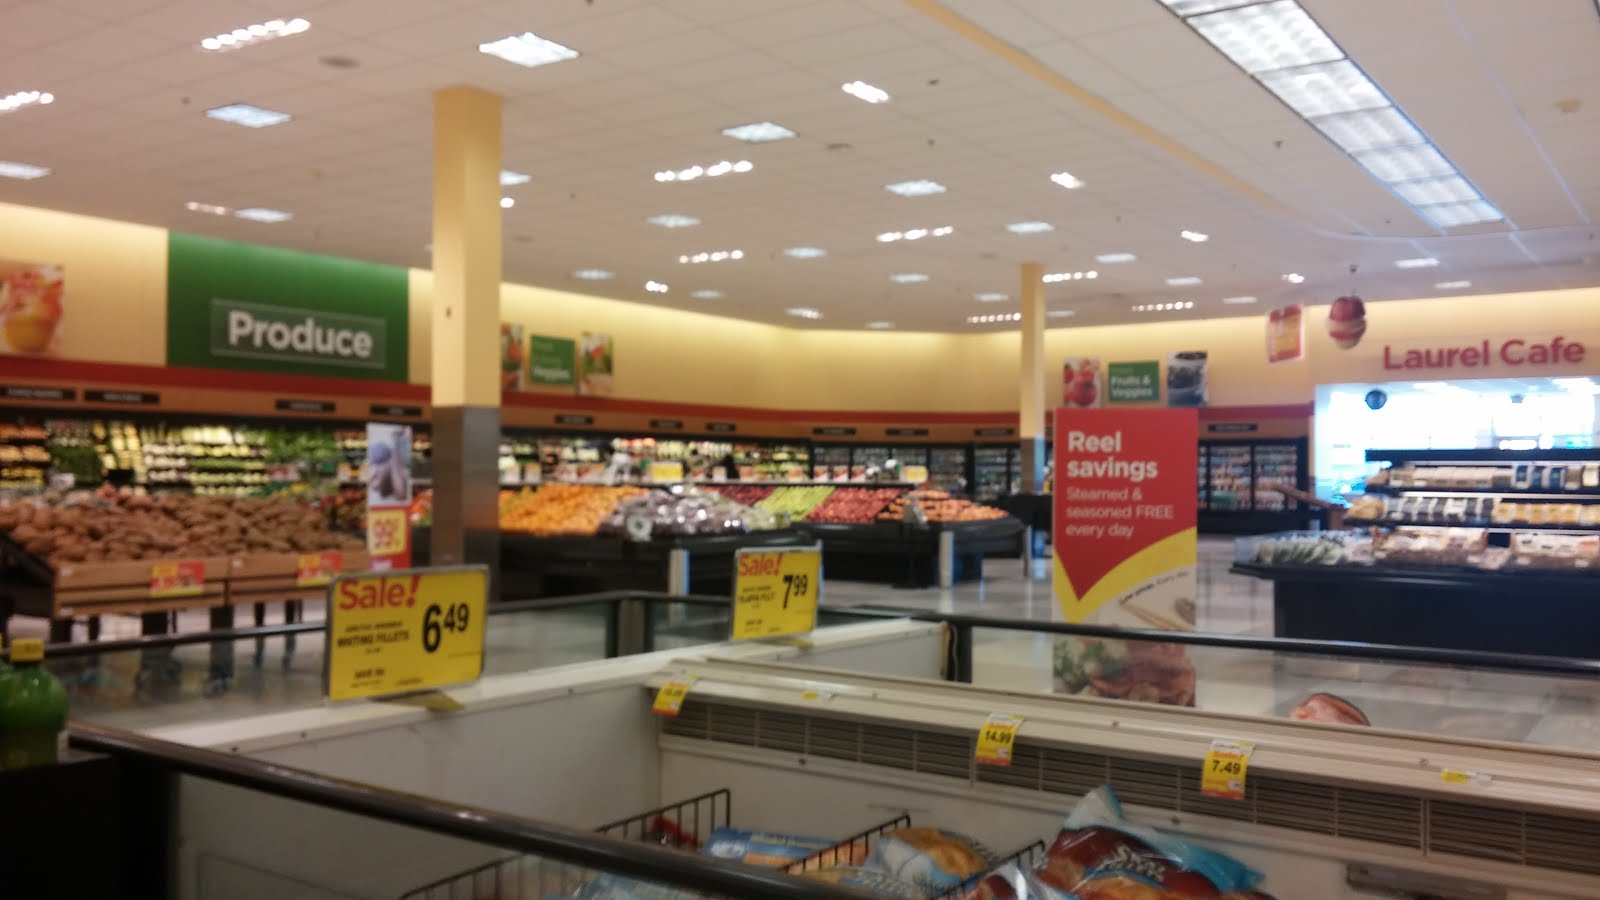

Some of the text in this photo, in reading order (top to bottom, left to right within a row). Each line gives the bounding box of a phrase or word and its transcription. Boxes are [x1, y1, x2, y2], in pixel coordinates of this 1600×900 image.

[228, 309, 373, 358] Produce
[1383, 333, 1586, 370] Laurel Cafe
[1067, 431, 1122, 452] Reel
[1066, 456, 1158, 482] savings
[1066, 487, 1142, 501] Steamed &
[1066, 504, 1174, 519] seasoned FREE
[1065, 522, 1134, 539] every day
[739, 552, 783, 576] Sale!
[339, 574, 421, 610] Sale!
[985, 729, 1012, 745] 14.99
[1212, 760, 1241, 775] 7.49
